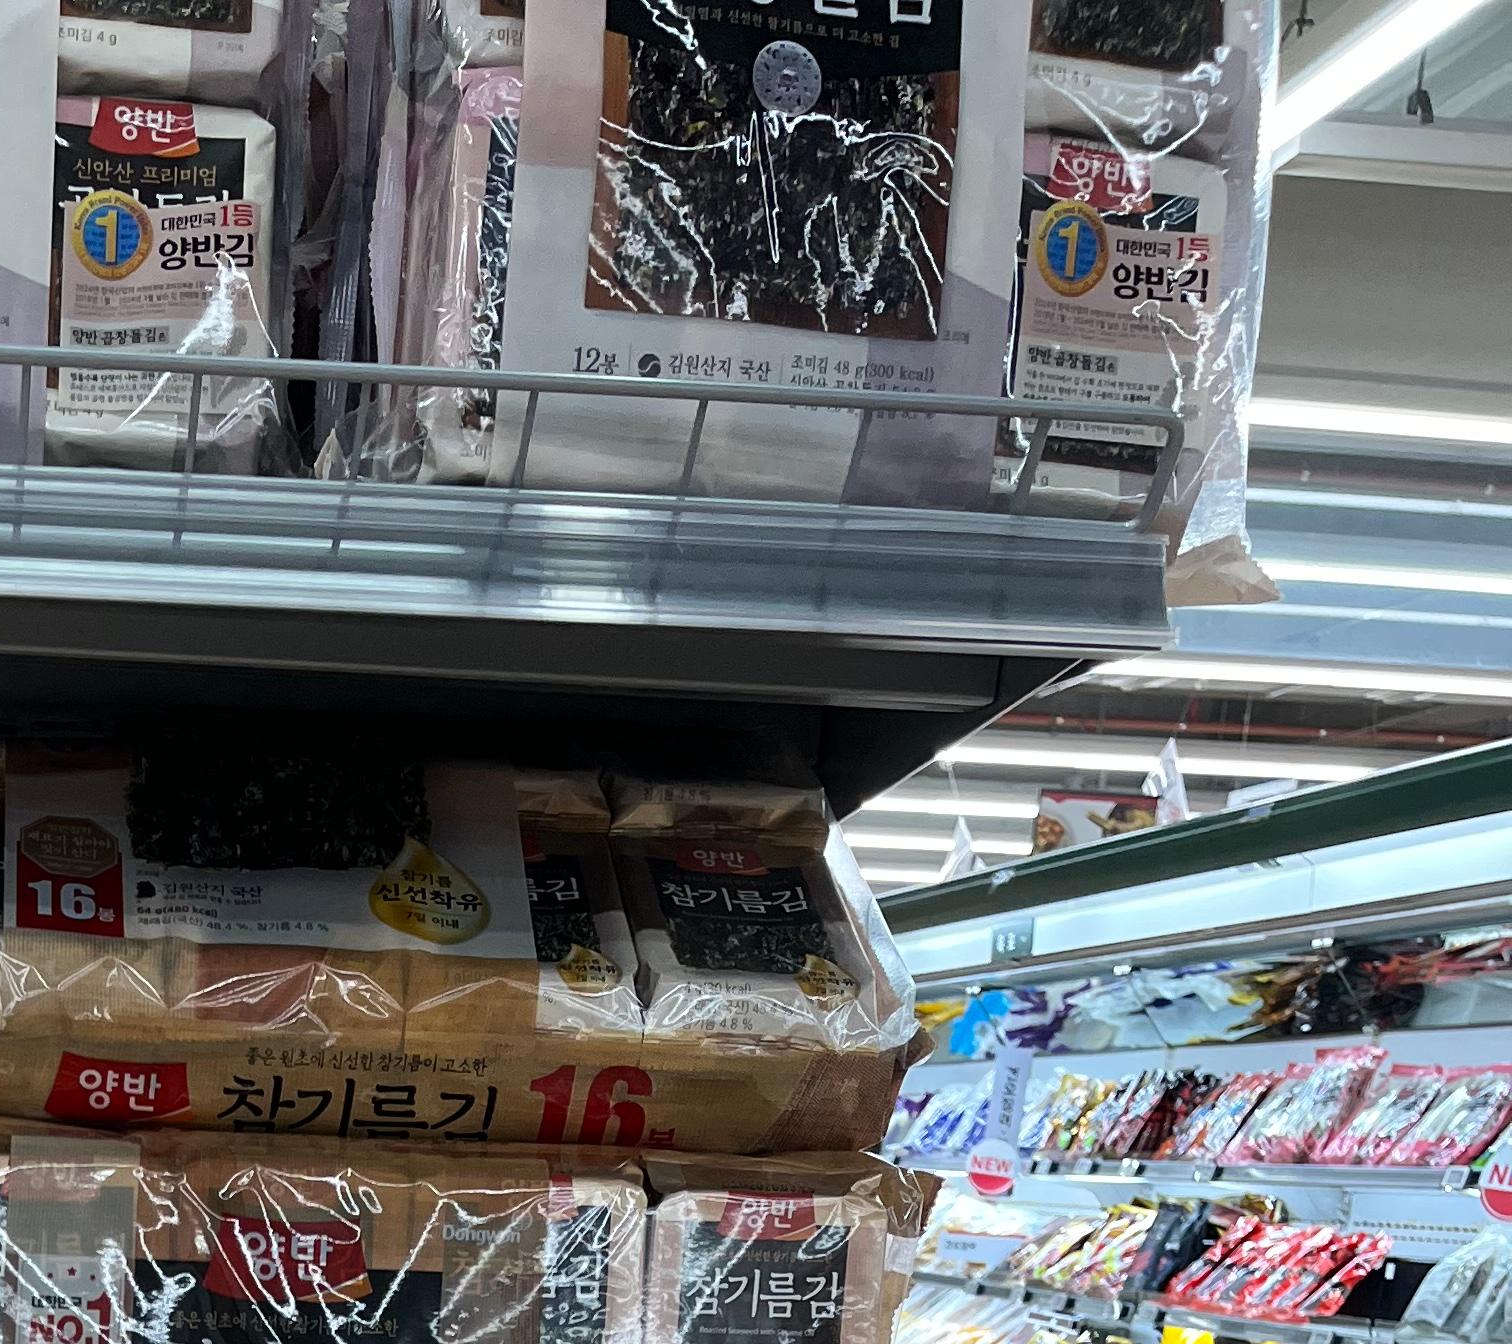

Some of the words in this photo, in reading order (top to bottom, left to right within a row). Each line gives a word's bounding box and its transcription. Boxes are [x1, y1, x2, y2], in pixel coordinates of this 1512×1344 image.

[73, 159, 134, 184] 신안산
[140, 165, 217, 187] 프리미엄
[161, 212, 216, 231] 대한민국
[220, 204, 253, 227] 1등
[1116, 238, 1170, 258] 대한민국
[1177, 236, 1210, 261] 1등
[572, 347, 620, 375] 12봉
[669, 354, 731, 378] 김원산지
[740, 359, 771, 382] 국산
[791, 354, 829, 374] 조미김
[834, 361, 850, 375] 48
[969, 1155, 1013, 1175] NEW
